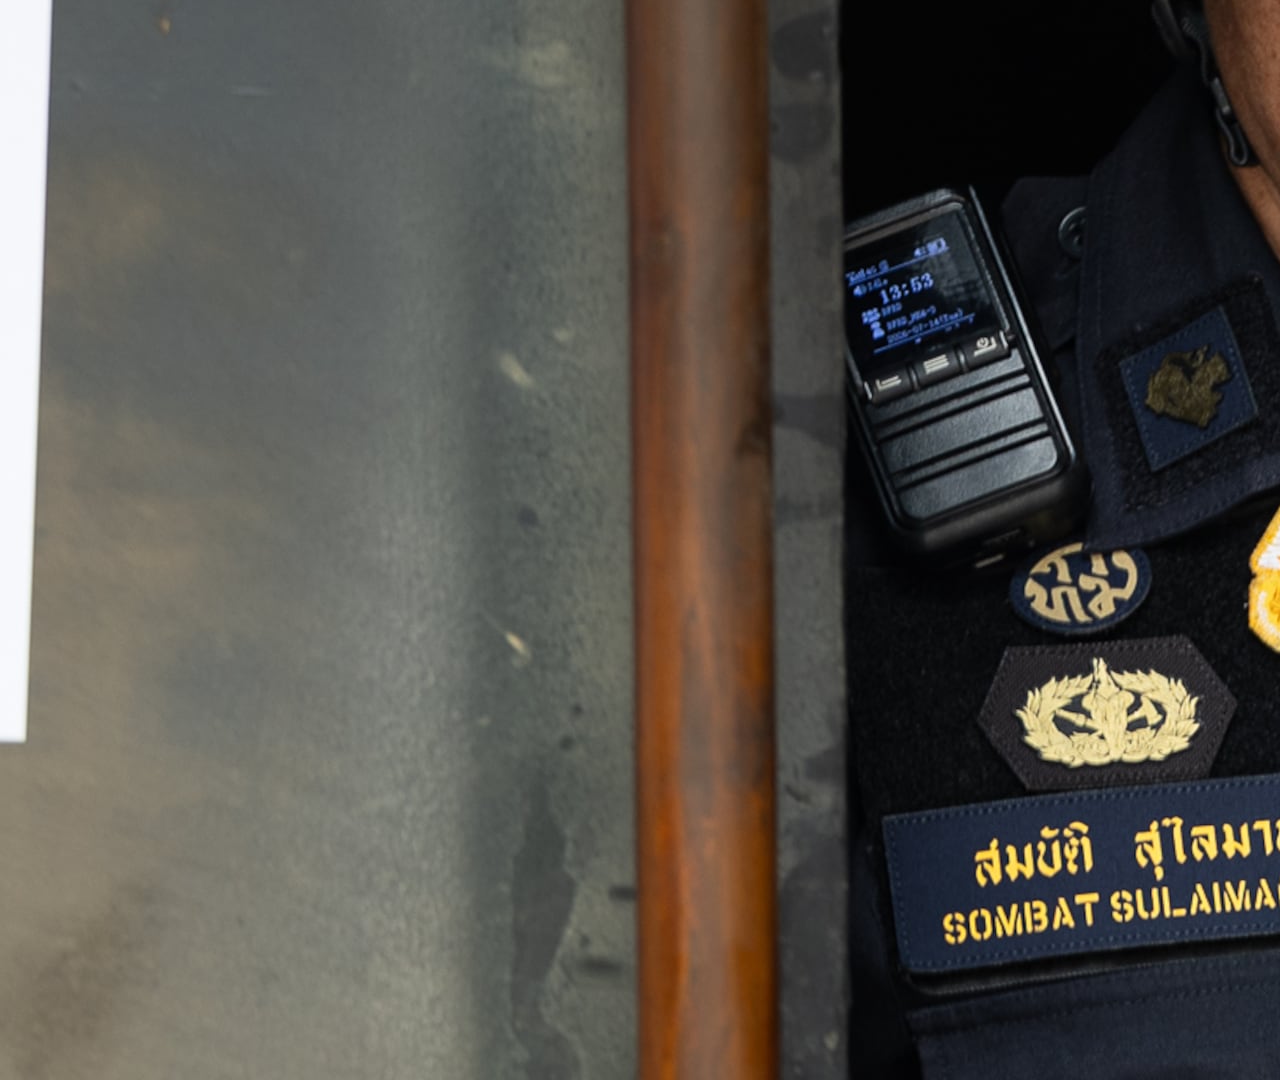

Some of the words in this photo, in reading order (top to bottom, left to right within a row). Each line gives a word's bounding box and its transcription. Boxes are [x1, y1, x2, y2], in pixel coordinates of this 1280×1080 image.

[880, 272, 935, 305] 13:53
[974, 821, 1094, 887] สมบัติ
[942, 891, 1100, 945] SOMBAT
